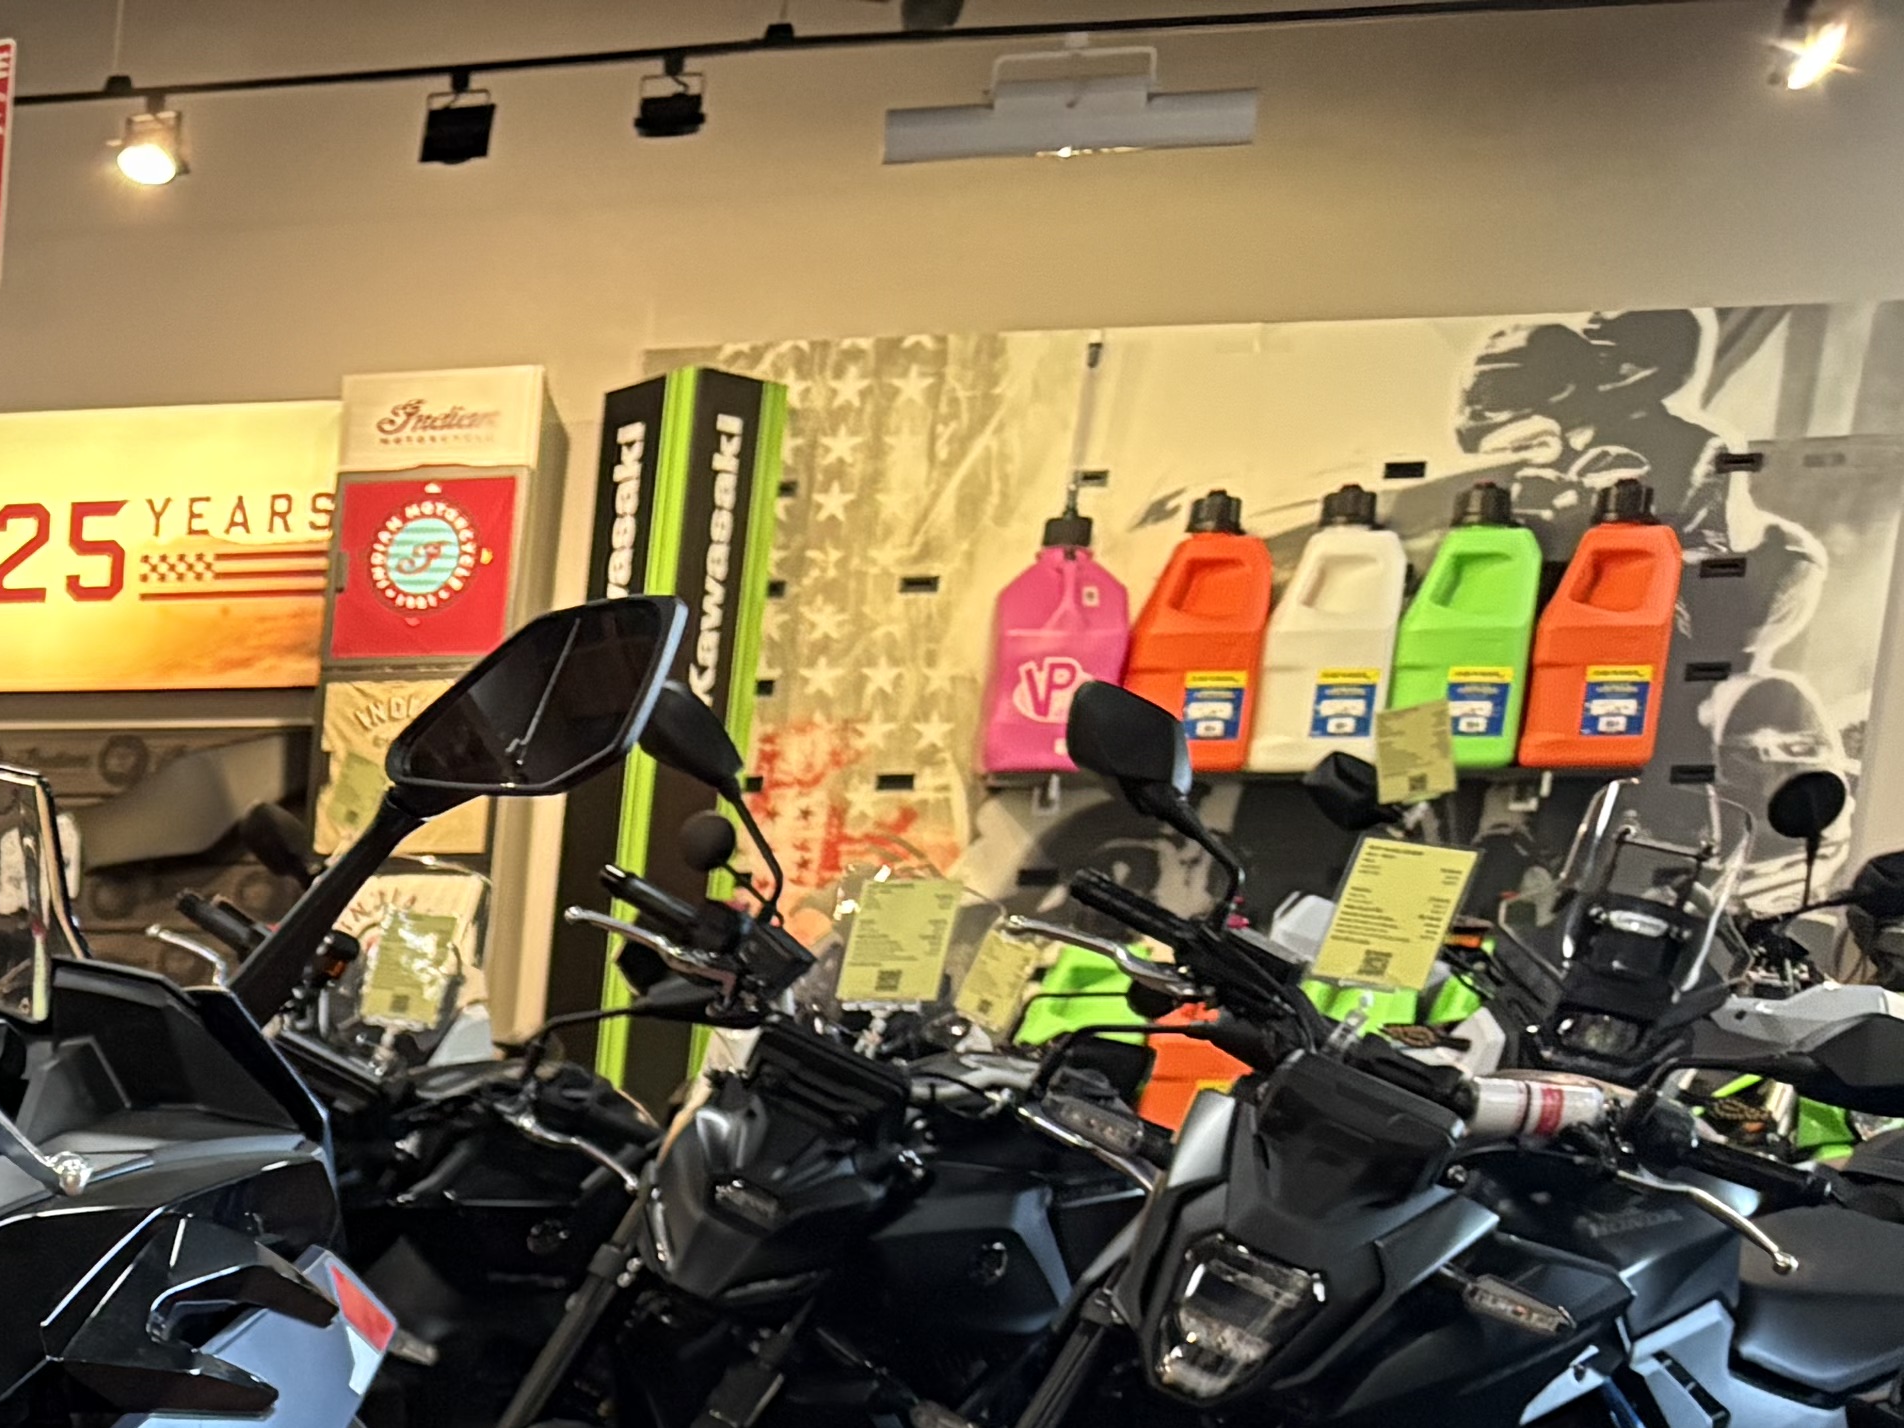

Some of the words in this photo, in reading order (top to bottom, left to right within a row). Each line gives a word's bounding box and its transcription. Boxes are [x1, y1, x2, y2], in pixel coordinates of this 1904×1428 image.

[376, 398, 501, 435] Indian
[144, 493, 337, 536] YEARS
[689, 413, 743, 707] Kawasaki
[1023, 658, 1079, 718] VP
